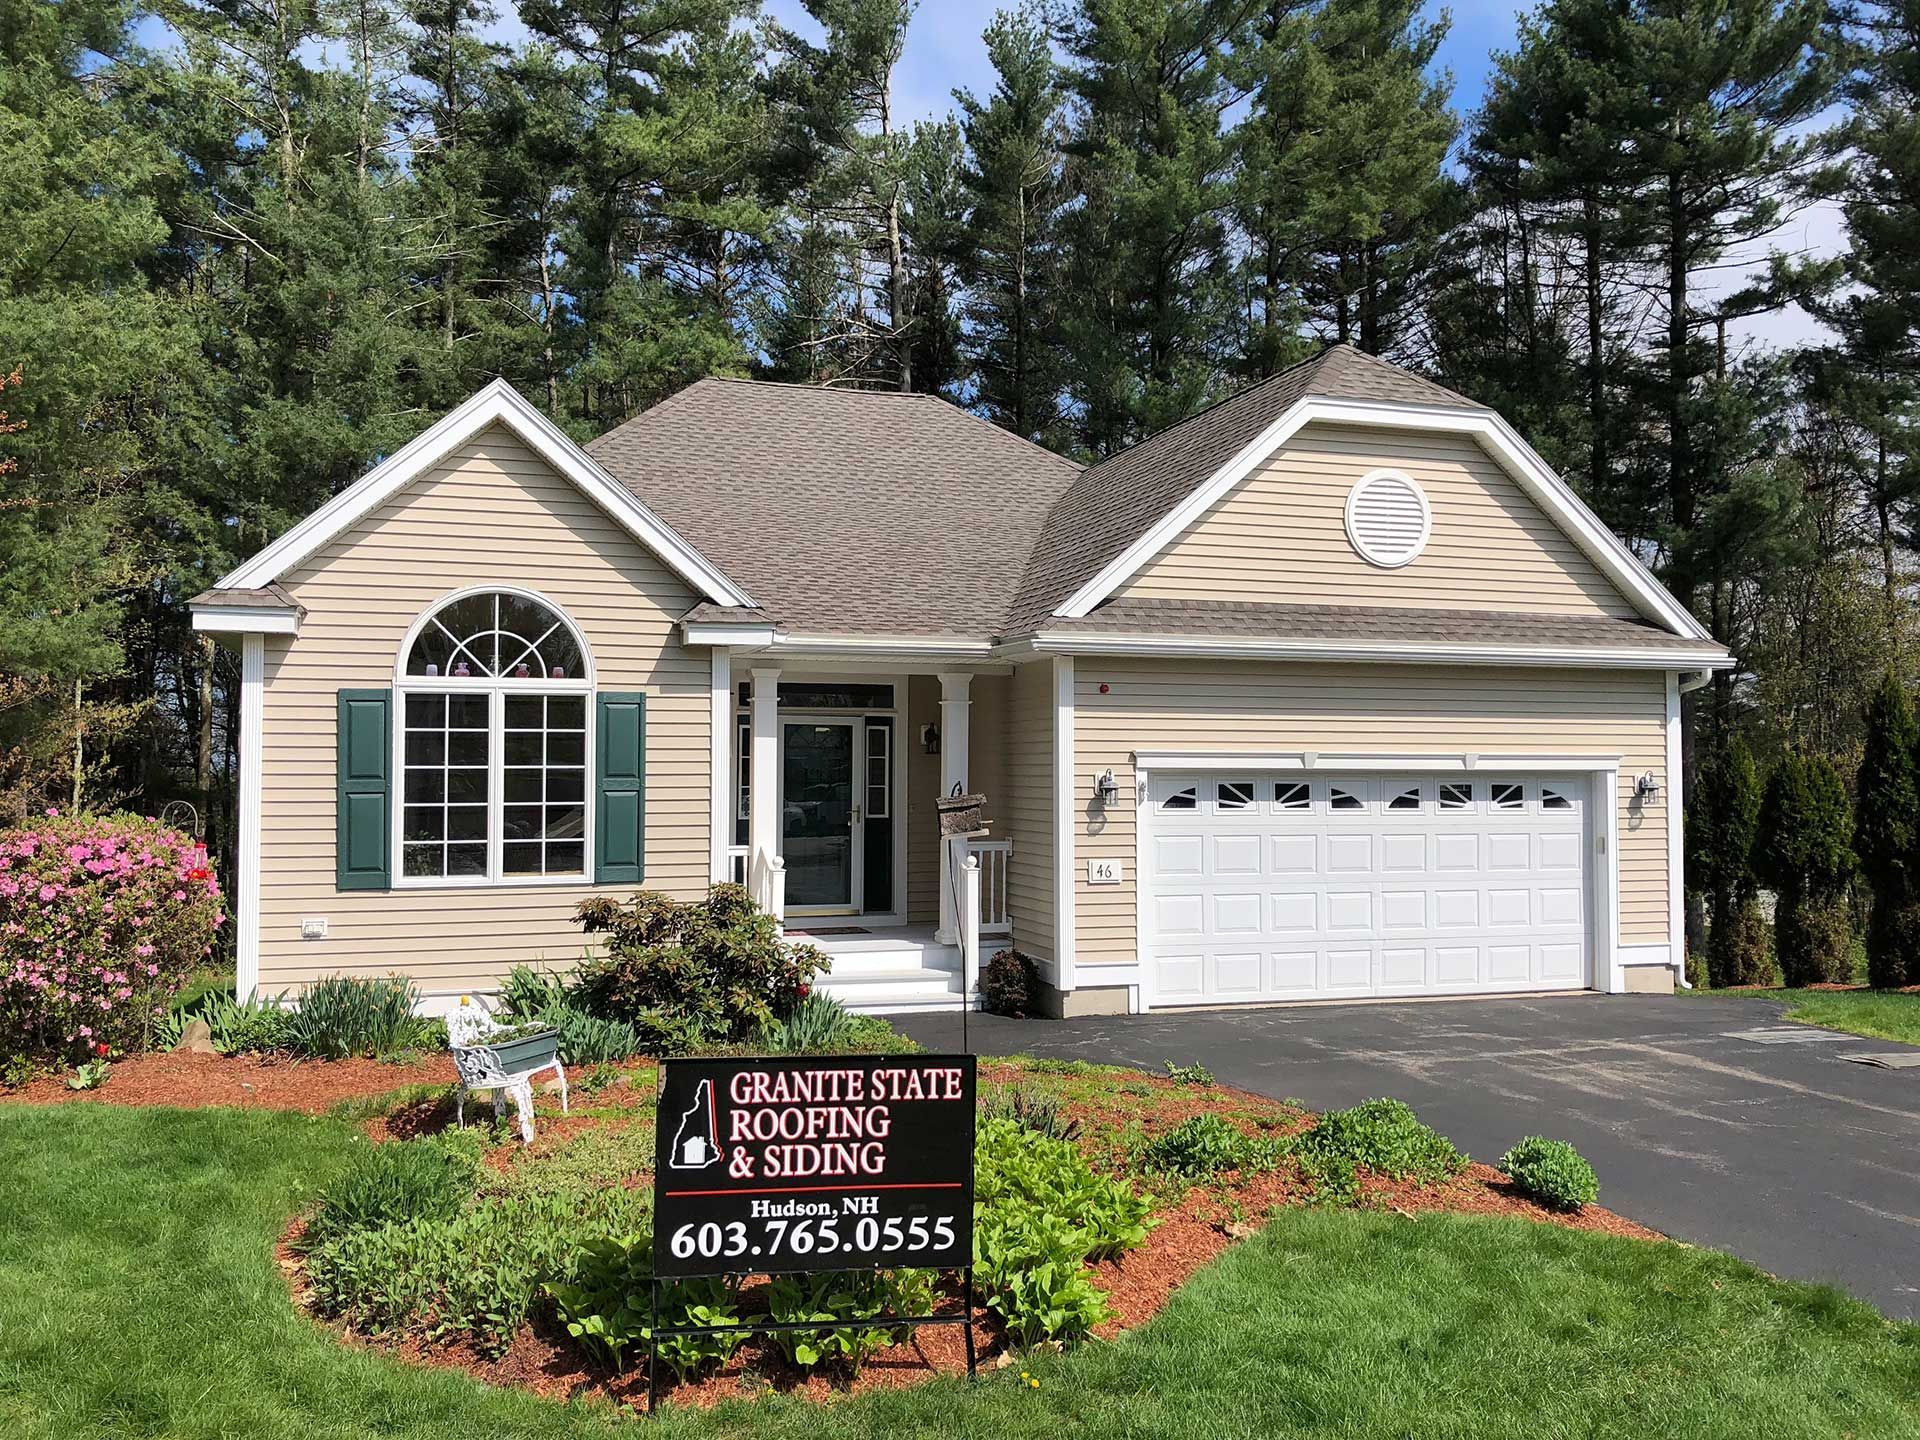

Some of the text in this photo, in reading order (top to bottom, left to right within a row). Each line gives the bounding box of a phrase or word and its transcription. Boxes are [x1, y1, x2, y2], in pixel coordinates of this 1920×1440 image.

[1096, 864, 1112, 878] 46
[730, 1068, 962, 1104] GRANITE STATE
[729, 1106, 891, 1141] ROOFING
[729, 1142, 886, 1179] & SIDING
[750, 1197, 879, 1219] Hudson, NH
[670, 1216, 955, 1258] 603.765.0555
